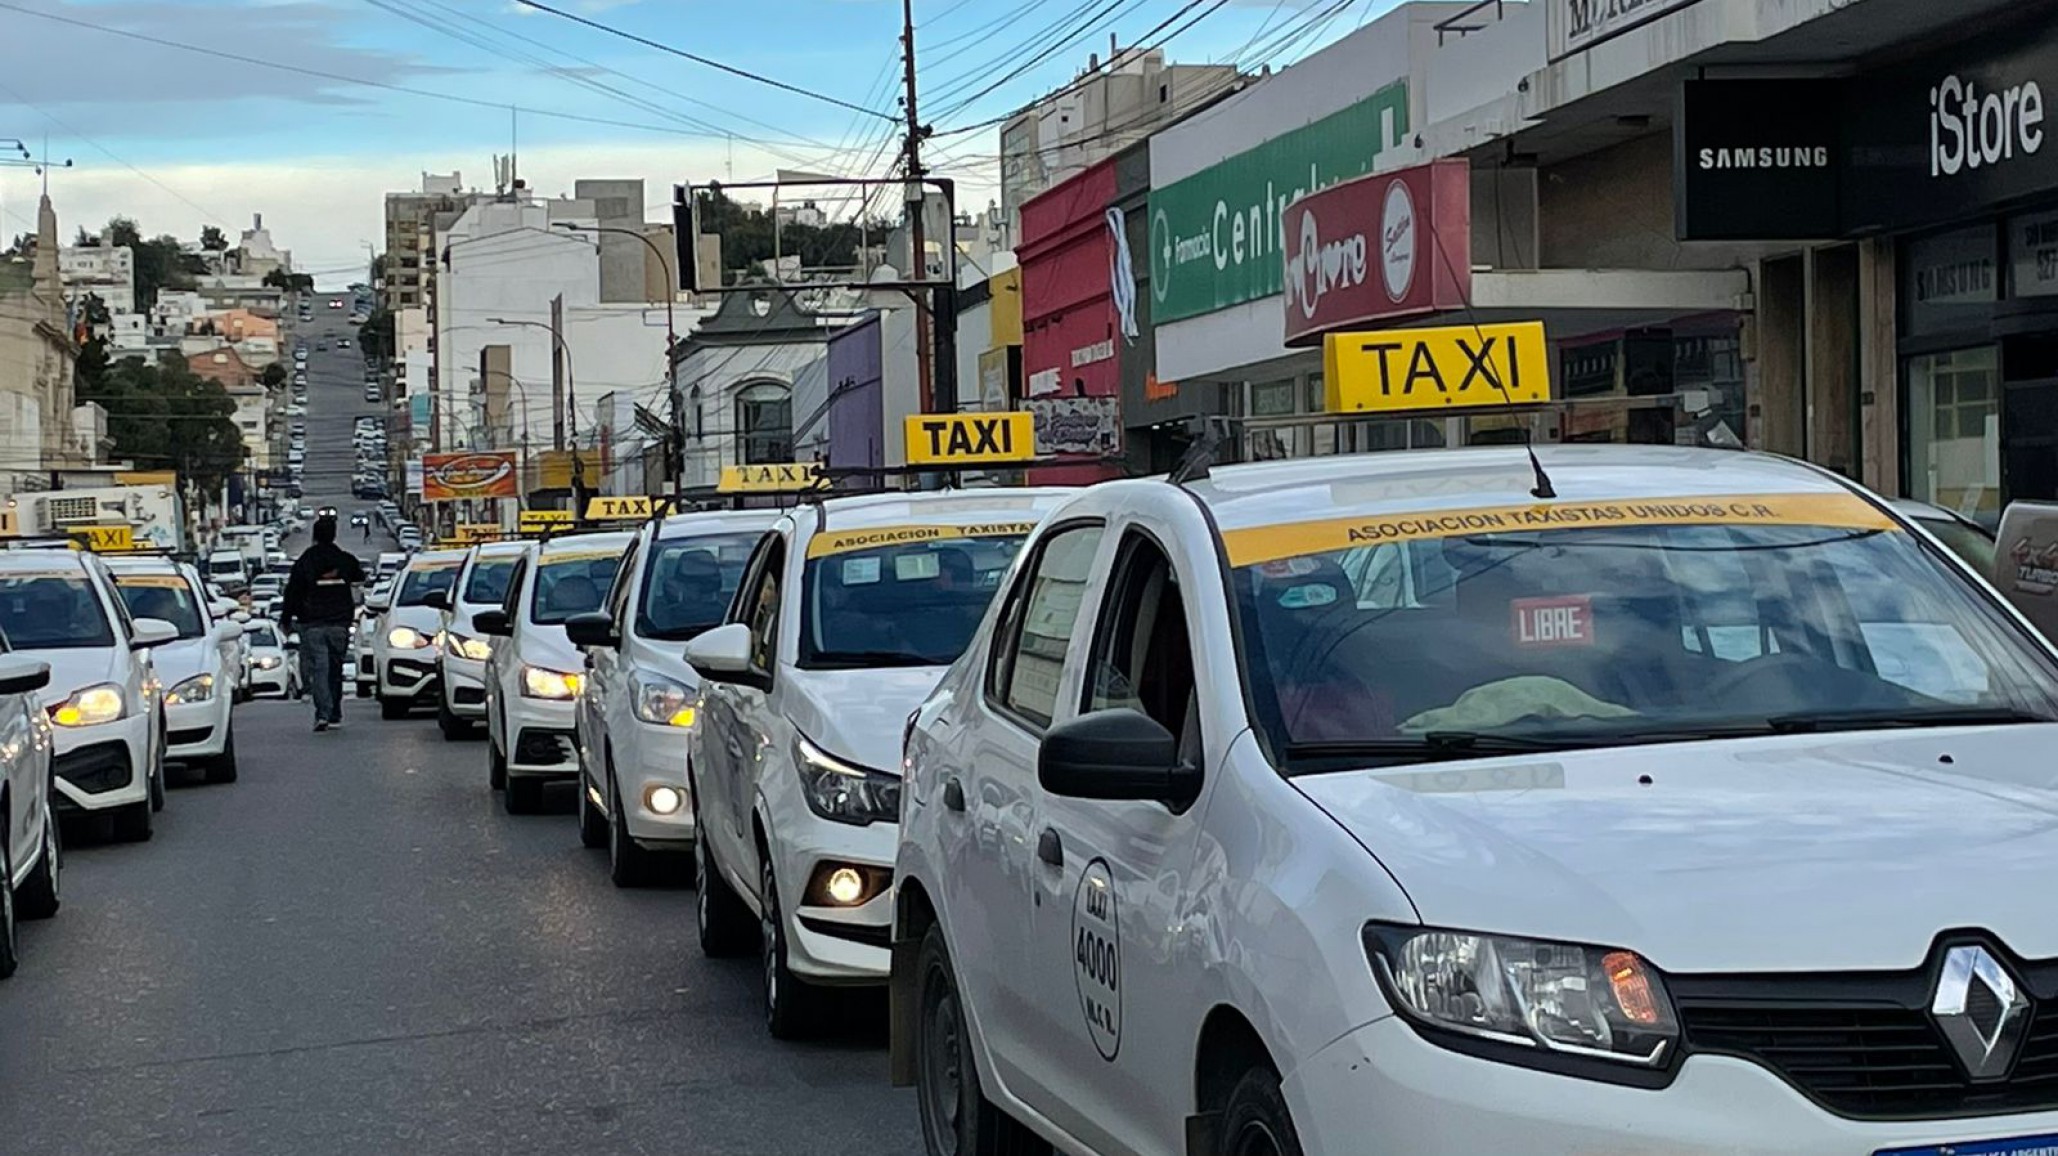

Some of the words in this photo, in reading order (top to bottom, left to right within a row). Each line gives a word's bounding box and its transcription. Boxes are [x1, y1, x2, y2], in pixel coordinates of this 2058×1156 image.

[1930, 75, 2044, 177] iStore
[1700, 147, 1828, 169] SAMSUNG
[1917, 258, 1991, 301] SAMSUNG
[1361, 335, 1521, 395] TAXI
[922, 418, 1014, 456] TAXI
[736, 464, 812, 484] TAXI
[602, 499, 649, 517] TAX
[1347, 512, 1503, 542] ASOCIACION
[1509, 503, 1626, 526] TAXISTAS
[1629, 499, 1725, 520] UNIDOS
[89, 528, 124, 547] AXI
[833, 528, 941, 549] ASOCIACION
[1518, 605, 1583, 643] LIBRE
[1077, 926, 1116, 991] 4000
